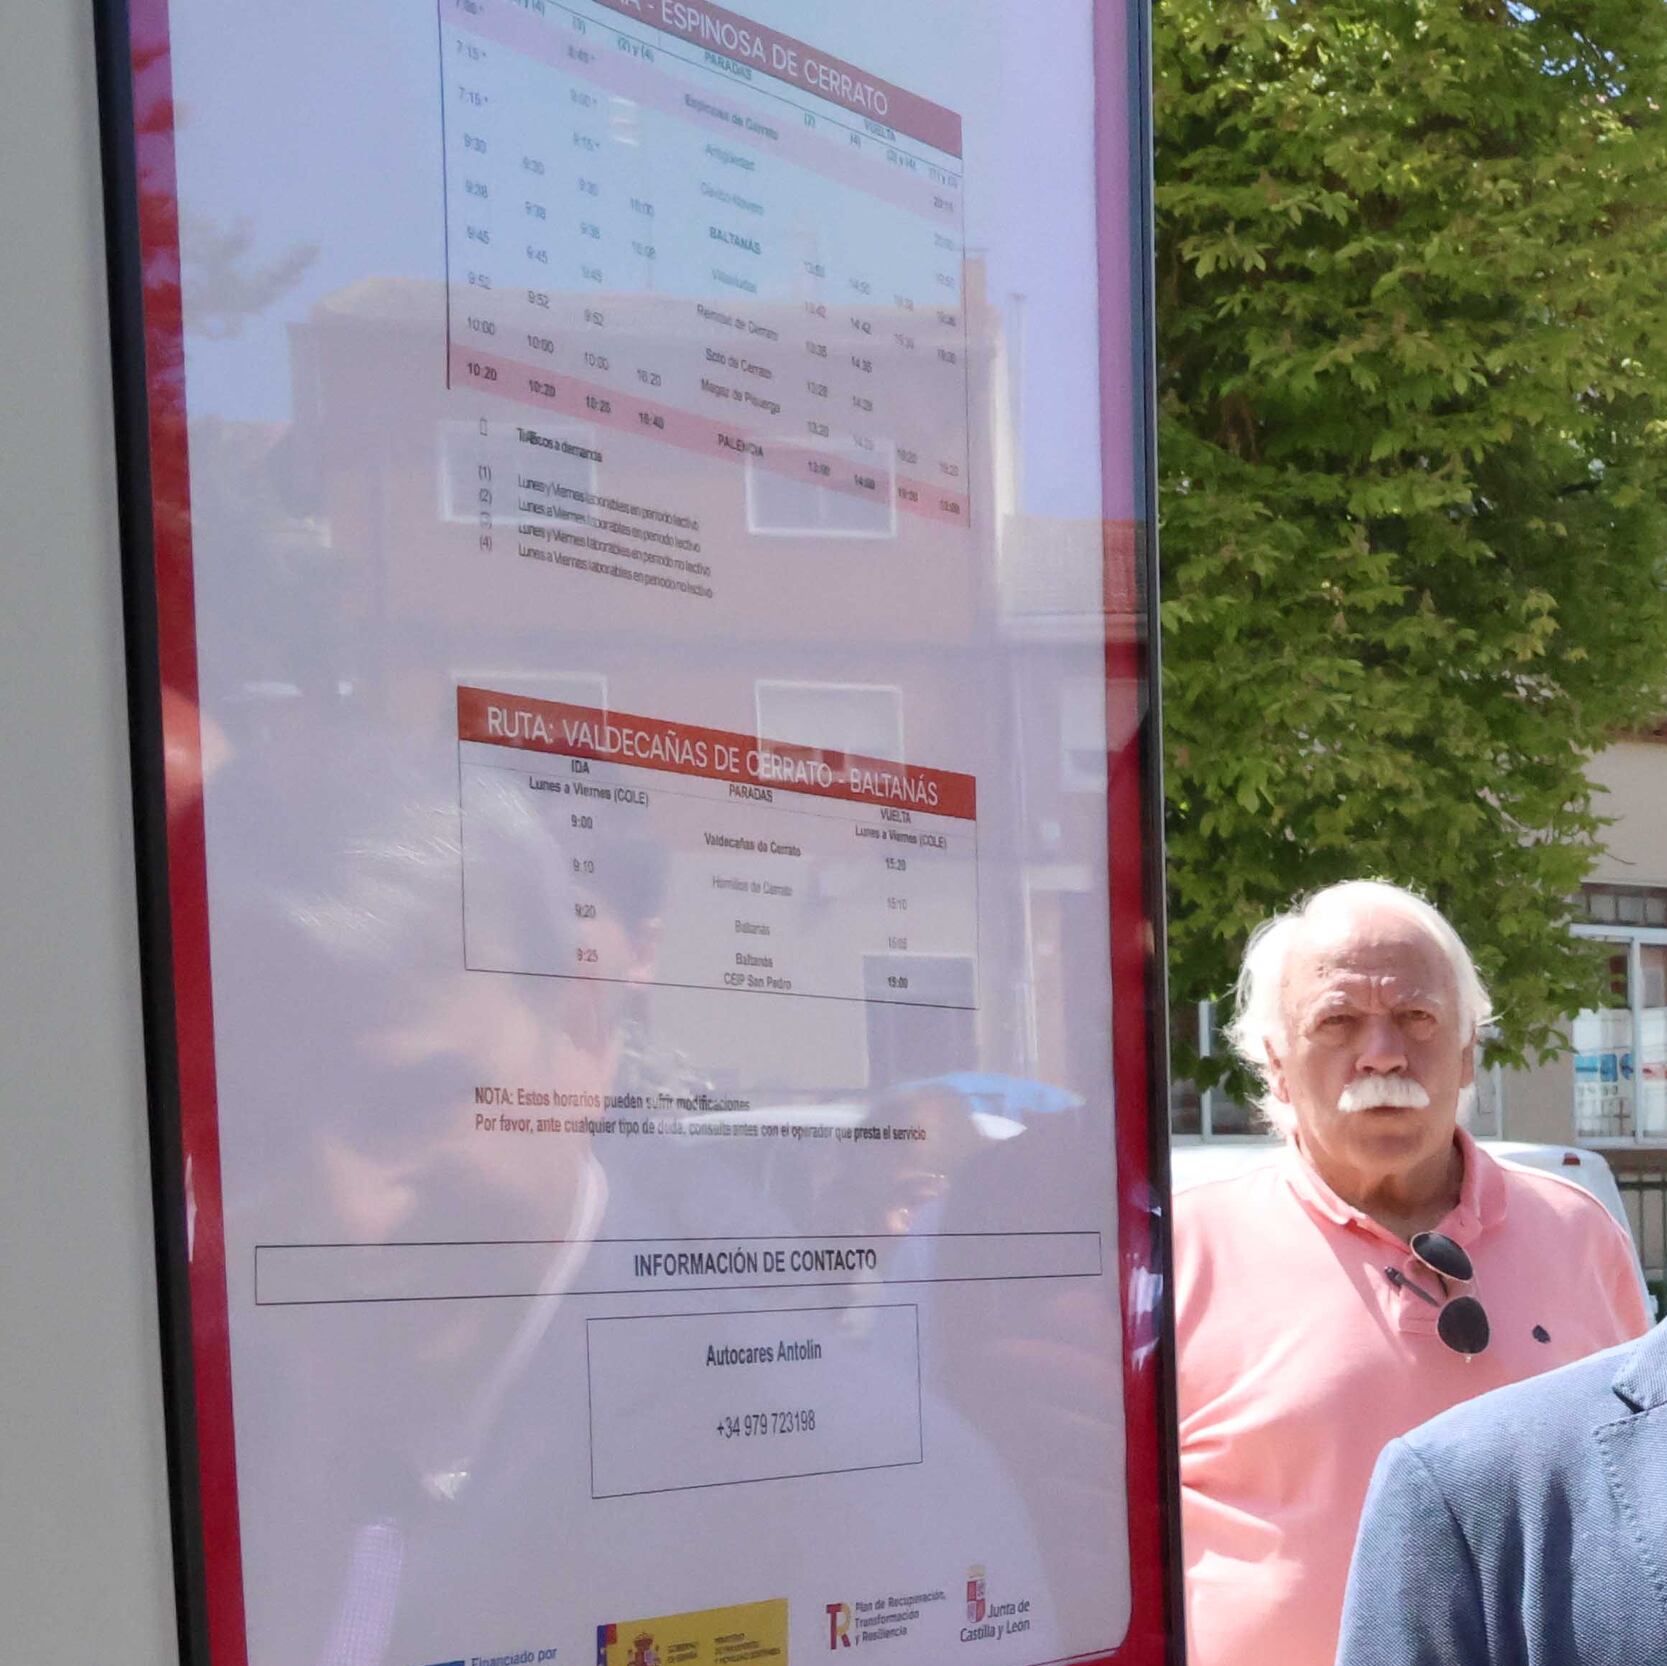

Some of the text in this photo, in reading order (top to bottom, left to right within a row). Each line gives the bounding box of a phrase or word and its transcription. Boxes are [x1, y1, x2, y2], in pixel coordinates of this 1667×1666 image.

[661, 0, 889, 116] ESPINOSA DE CERRATO
[703, 51, 752, 81] PARADAS
[528, 289, 551, 310] 9:52
[467, 316, 497, 336] 10:00
[527, 334, 555, 355] 10:00
[467, 361, 498, 382] 10:20
[740, 359, 773, 381] Cerrato
[529, 378, 557, 398] 10:20
[717, 432, 766, 458] PALENCIA
[478, 465, 493, 482] (1)
[479, 487, 493, 505] (2)
[518, 475, 545, 493] Lunes
[551, 483, 585, 503] Viernes
[518, 497, 545, 516] Lunes
[552, 501, 586, 523] Viernes
[479, 535, 493, 552] (4)
[551, 527, 587, 548] Viernes
[518, 543, 546, 562] Lunes
[552, 549, 587, 571] Viernes
[487, 706, 554, 745] RUTA:
[562, 718, 708, 768] VALDECAÑAS
[714, 744, 741, 774] DE
[746, 750, 833, 788] CERRATO
[850, 768, 939, 806] BALTANÁS
[571, 759, 590, 774] IDA
[529, 776, 649, 808] Lunes a Viernes (COLE)
[728, 783, 774, 803] PARADAS
[570, 814, 594, 830] 9:00
[880, 808, 912, 824] VUELTA
[704, 832, 802, 857] Valdecañas de Cerrato
[855, 824, 948, 849] Lunes a Viernes (COLE)
[573, 858, 594, 874] 9:10
[750, 880, 761, 893] de
[763, 881, 793, 897] Cerrato
[575, 903, 597, 920] 9:20
[576, 949, 599, 963] 9:25
[735, 952, 774, 968] Baltanás
[724, 972, 792, 990] CEIP San Pedro
[475, 1086, 514, 1106] NOTA:
[518, 1088, 550, 1107] Estos
[552, 1089, 601, 1109] horarios
[604, 1093, 643, 1113] pueden
[676, 1093, 750, 1112] modificaciones
[475, 1113, 497, 1132] Por
[499, 1114, 534, 1134] favor,
[537, 1117, 562, 1133] ante
[564, 1115, 617, 1137] cualquier
[619, 1117, 640, 1137] tipo
[642, 1118, 655, 1134] de
[761, 1124, 779, 1138] con
[781, 1122, 790, 1138] el
[792, 1123, 833, 1141] operador
[835, 1126, 853, 1142] que
[854, 1126, 882, 1142] presta
[883, 1125, 891, 1140] el
[893, 1125, 927, 1141] servicio
[634, 1247, 877, 1277] INFORMACIÓN DE CONTACTO
[706, 1344, 774, 1367] Autocares
[716, 1409, 816, 1439] +34 979 723198
[855, 1590, 946, 1612] Plan de Recuperación,
[987, 1599, 1030, 1620] Junta de
[855, 1610, 920, 1629] Transformación
[855, 1627, 908, 1646] y Resiliencia
[960, 1618, 1030, 1643] Castilla y León
[537, 1647, 558, 1666] por
